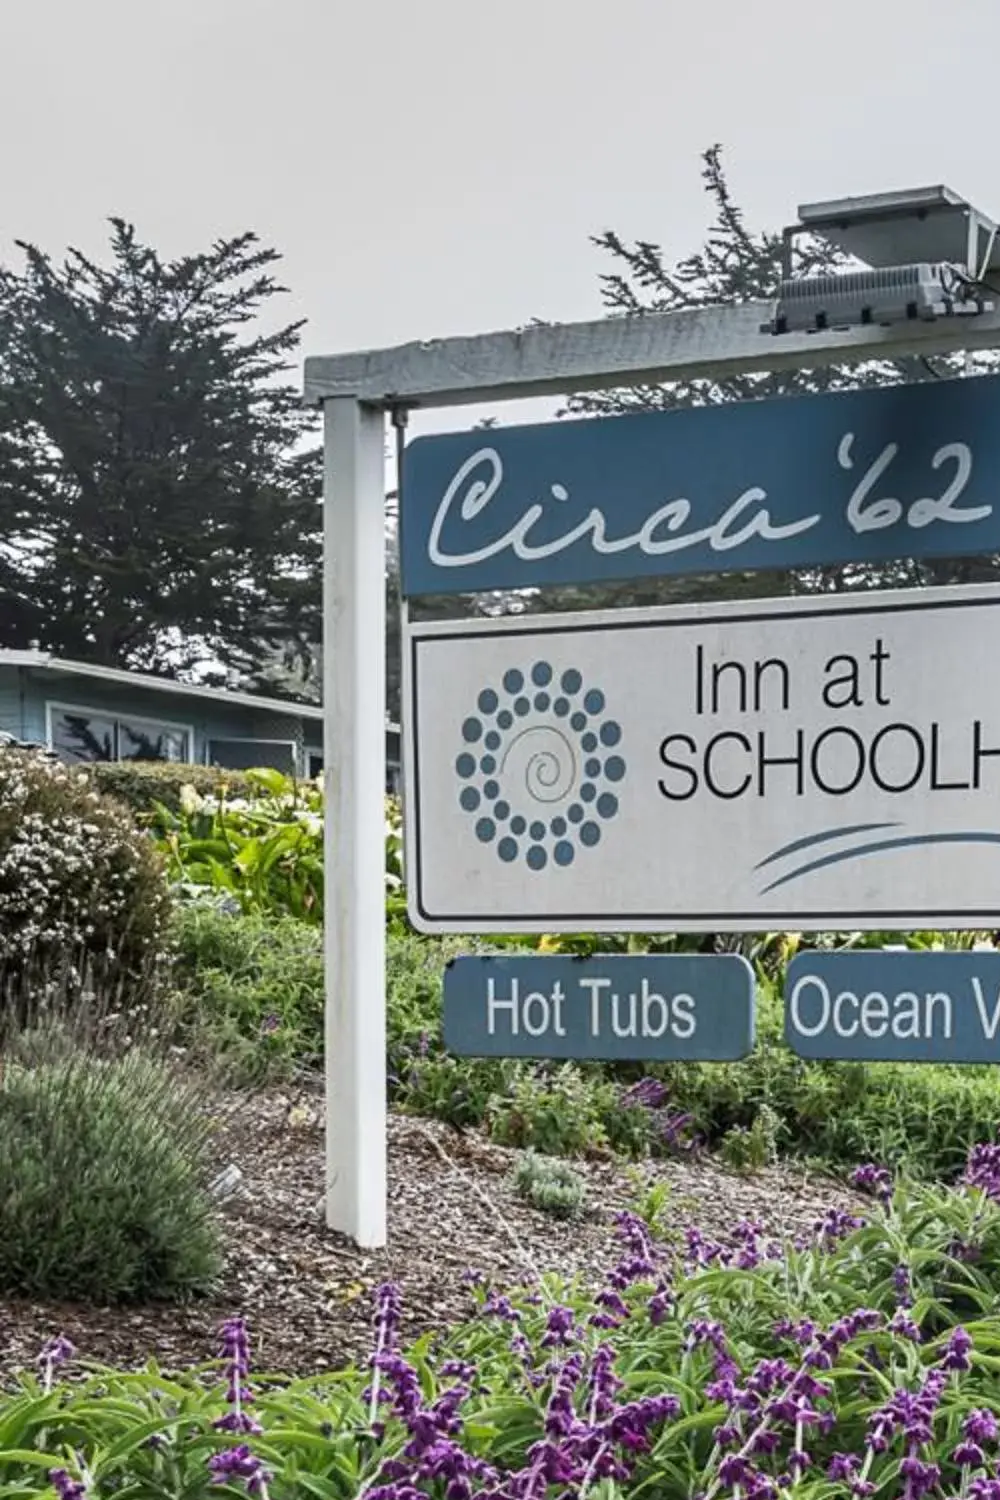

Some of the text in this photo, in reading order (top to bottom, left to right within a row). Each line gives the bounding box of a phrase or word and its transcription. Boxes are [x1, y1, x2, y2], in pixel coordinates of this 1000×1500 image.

[428, 447, 821, 567] Circa
[697, 639, 891, 714] Inn at
[487, 977, 696, 1038] Hot Tubs
[790, 975, 951, 1038] Ocean
